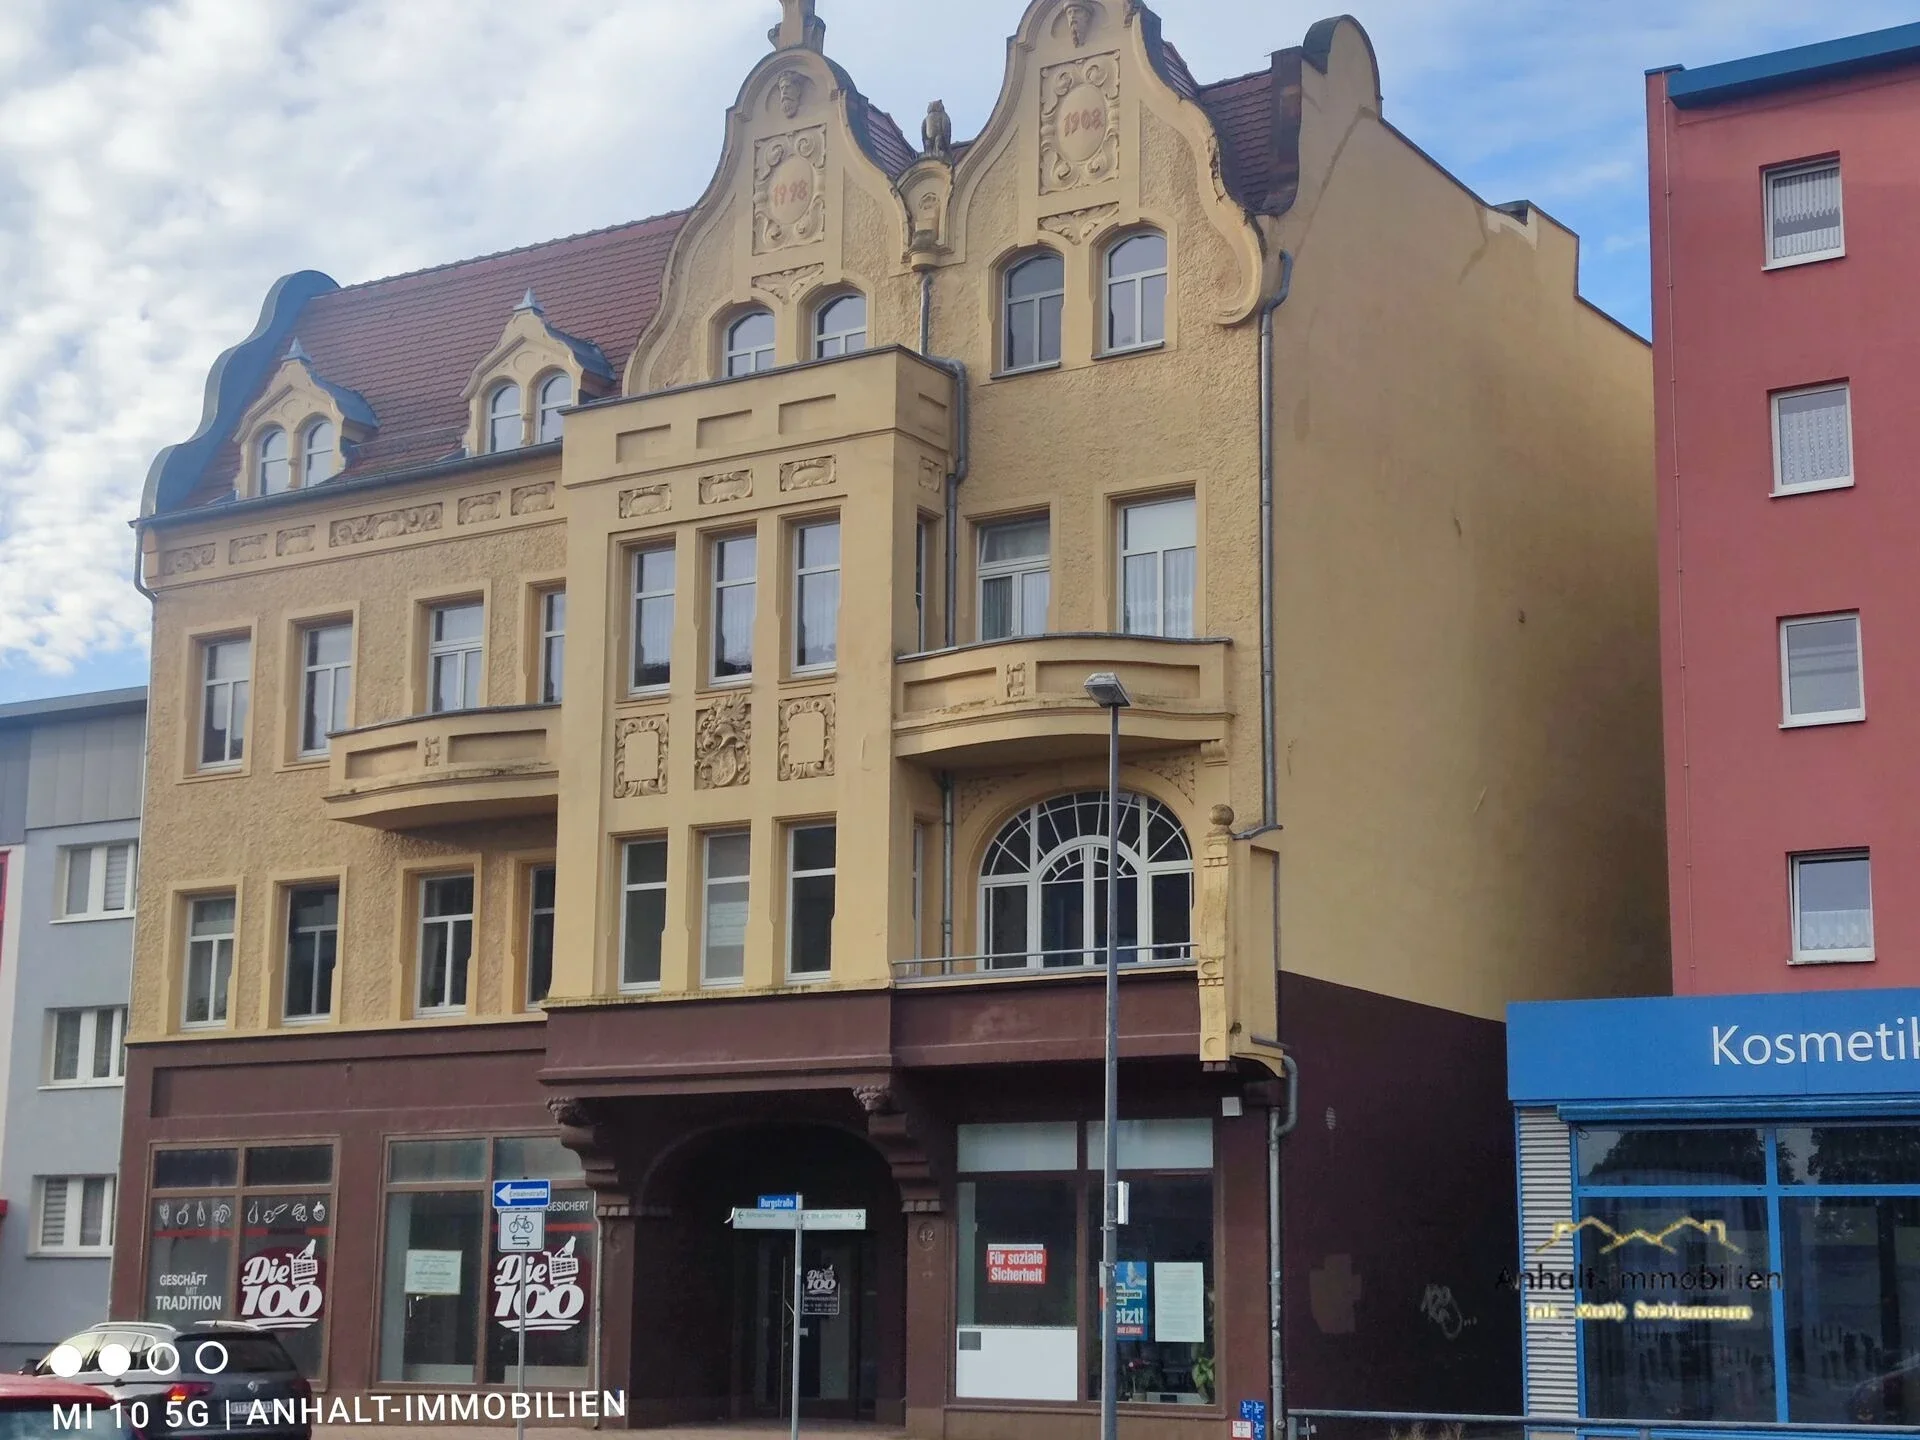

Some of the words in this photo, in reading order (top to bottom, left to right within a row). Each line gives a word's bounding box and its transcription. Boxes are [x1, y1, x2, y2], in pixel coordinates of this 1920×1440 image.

[1063, 108, 1101, 136] 1908
[760, 1198, 794, 1210] Burgstraße
[989, 1250, 1006, 1265] Für
[1007, 1250, 1043, 1265] soziale
[241, 1256, 289, 1285] Die
[493, 1254, 548, 1285] Die
[991, 1266, 1043, 1282] Sicherheit
[159, 1272, 208, 1287] GESCHÄFT
[806, 1279, 837, 1290] 100
[184, 1287, 198, 1296] MIT
[155, 1295, 222, 1311] TRADITION
[240, 1283, 324, 1318] 100
[493, 1283, 585, 1319] 100
